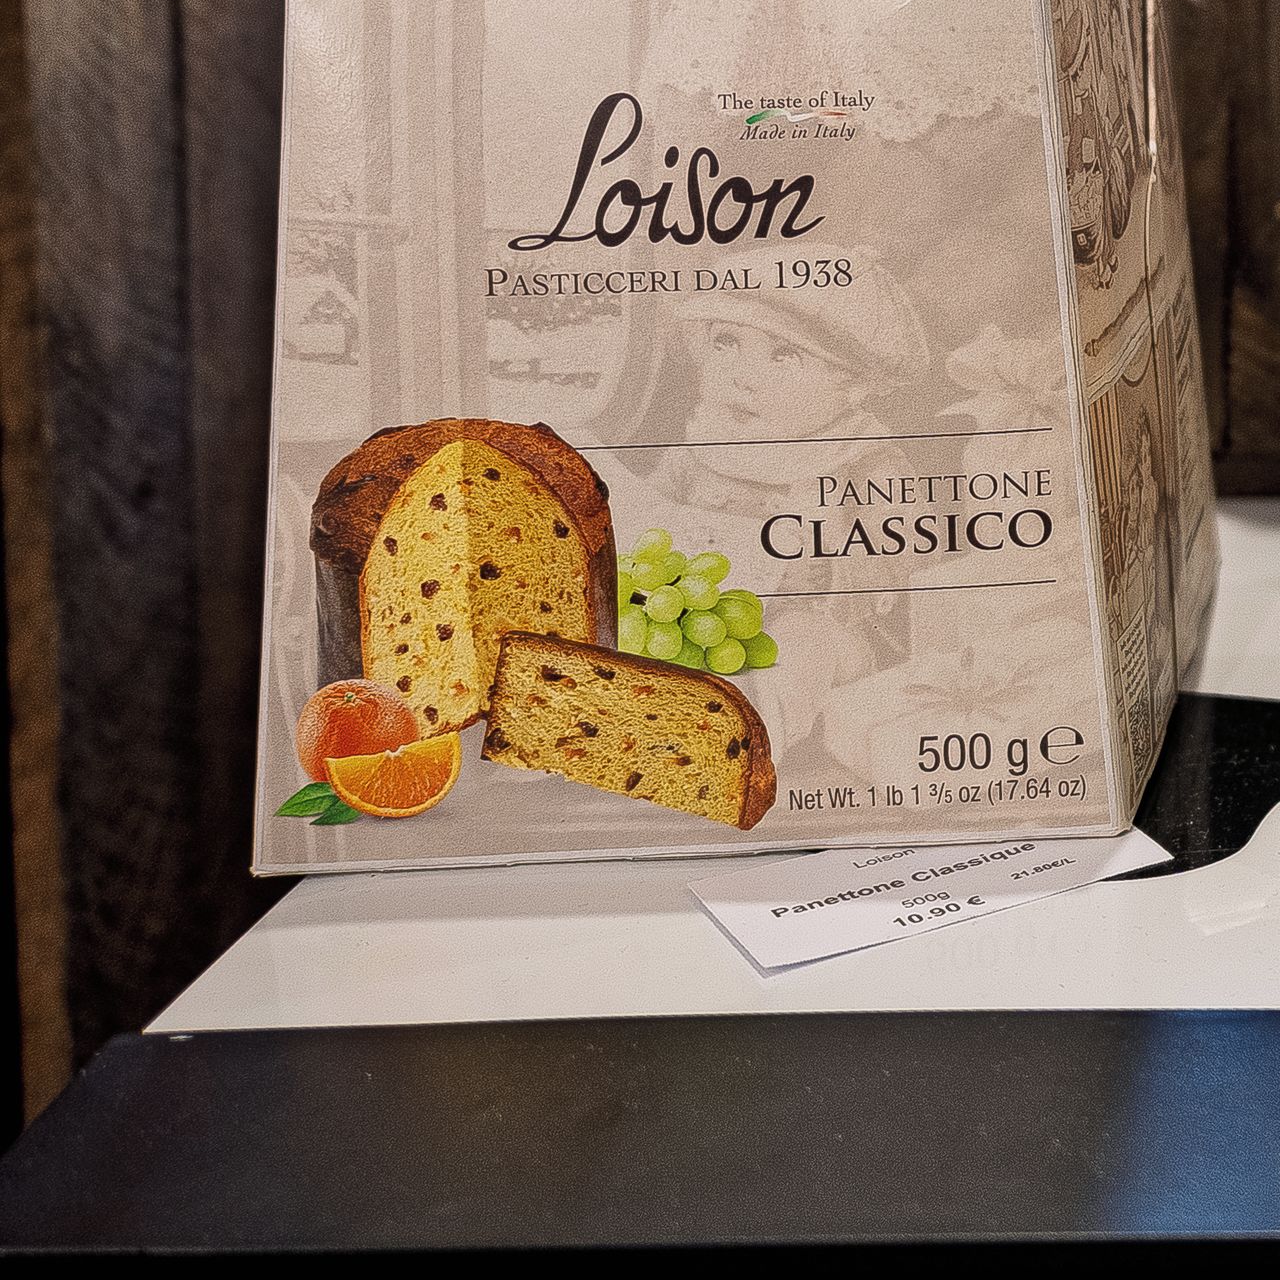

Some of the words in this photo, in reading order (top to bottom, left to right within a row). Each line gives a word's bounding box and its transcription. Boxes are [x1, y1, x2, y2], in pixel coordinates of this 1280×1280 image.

[718, 93, 753, 109] The
[760, 96, 802, 109] taste
[808, 91, 828, 108] of
[833, 90, 875, 111] Italy
[740, 124, 785, 140] Made
[792, 125, 808, 140] in
[814, 122, 855, 141] Italy
[508, 92, 826, 251] Loison
[484, 266, 681, 297] PASTICCERI
[694, 268, 761, 292] DAL
[774, 259, 854, 290] 1938
[816, 470, 1052, 508] PANETTONE
[760, 511, 1053, 561] CLASSICO
[918, 732, 992, 772] 500
[1007, 737, 1029, 776] g
[789, 789, 824, 810] Net
[828, 787, 861, 808] Wt.
[867, 785, 877, 806] 1
[887, 784, 903, 806] lb
[911, 784, 921, 805] 1
[959, 784, 981, 803] oz
[987, 778, 1051, 806] (17.64
[1058, 775, 1087, 801] oz)
[852, 848, 915, 868] Loison
[1011, 857, 1076, 880] 21.80€/L
[770, 879, 906, 918] Panettone
[911, 842, 1036, 882] Classique
[892, 903, 961, 927] 10.90
[967, 895, 986, 907] €
[902, 891, 950, 909] 500g
